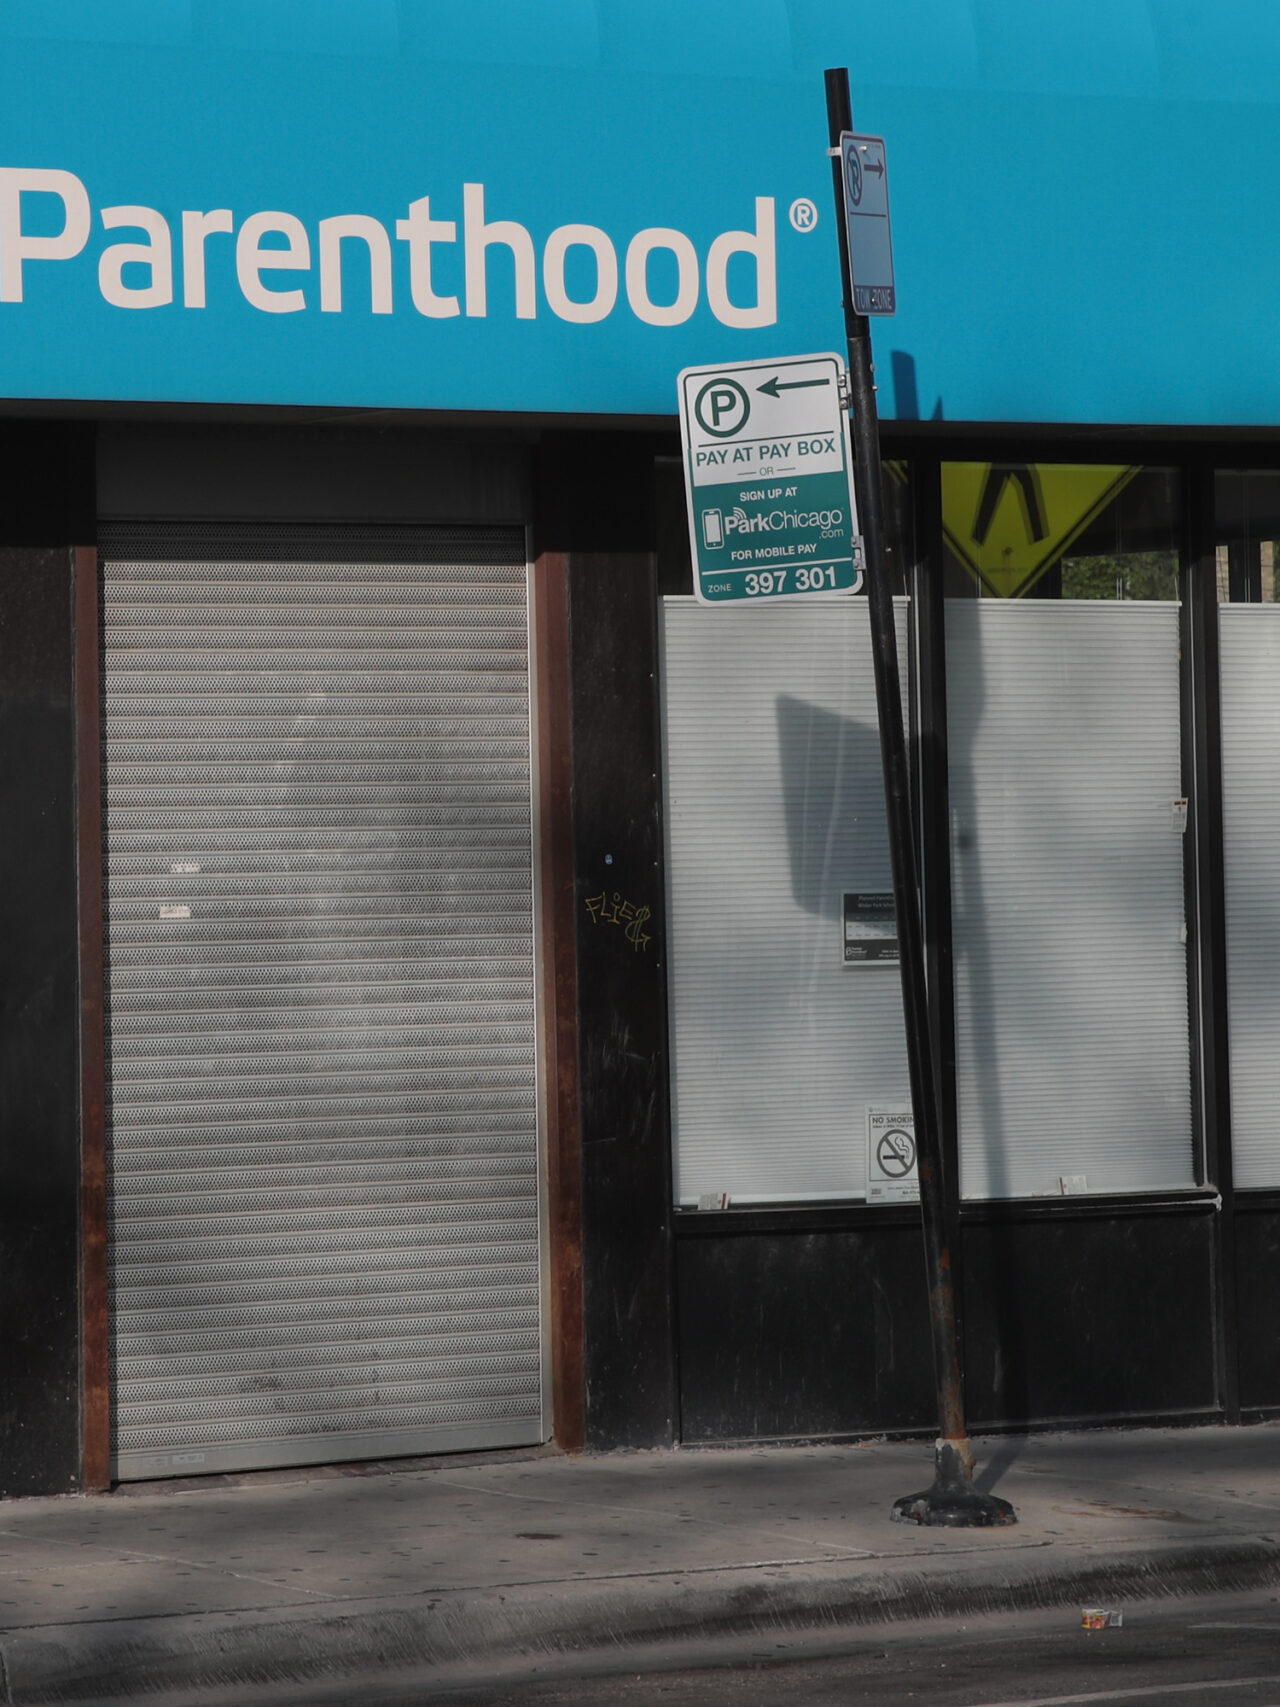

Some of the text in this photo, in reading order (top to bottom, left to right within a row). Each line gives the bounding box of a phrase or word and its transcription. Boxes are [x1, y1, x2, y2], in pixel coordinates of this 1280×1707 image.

[696, 438, 836, 467] PAY AT PAY BOX
[759, 466, 774, 476] OR
[740, 486, 798, 502] SIGN UP AT
[724, 509, 843, 535] ParkChicago
[819, 528, 844, 539] .com
[731, 543, 817, 561] FOR MOBILE PAY
[708, 566, 836, 595] ZONE 397 301
[872, 1116, 914, 1124] NO SMOKIN
